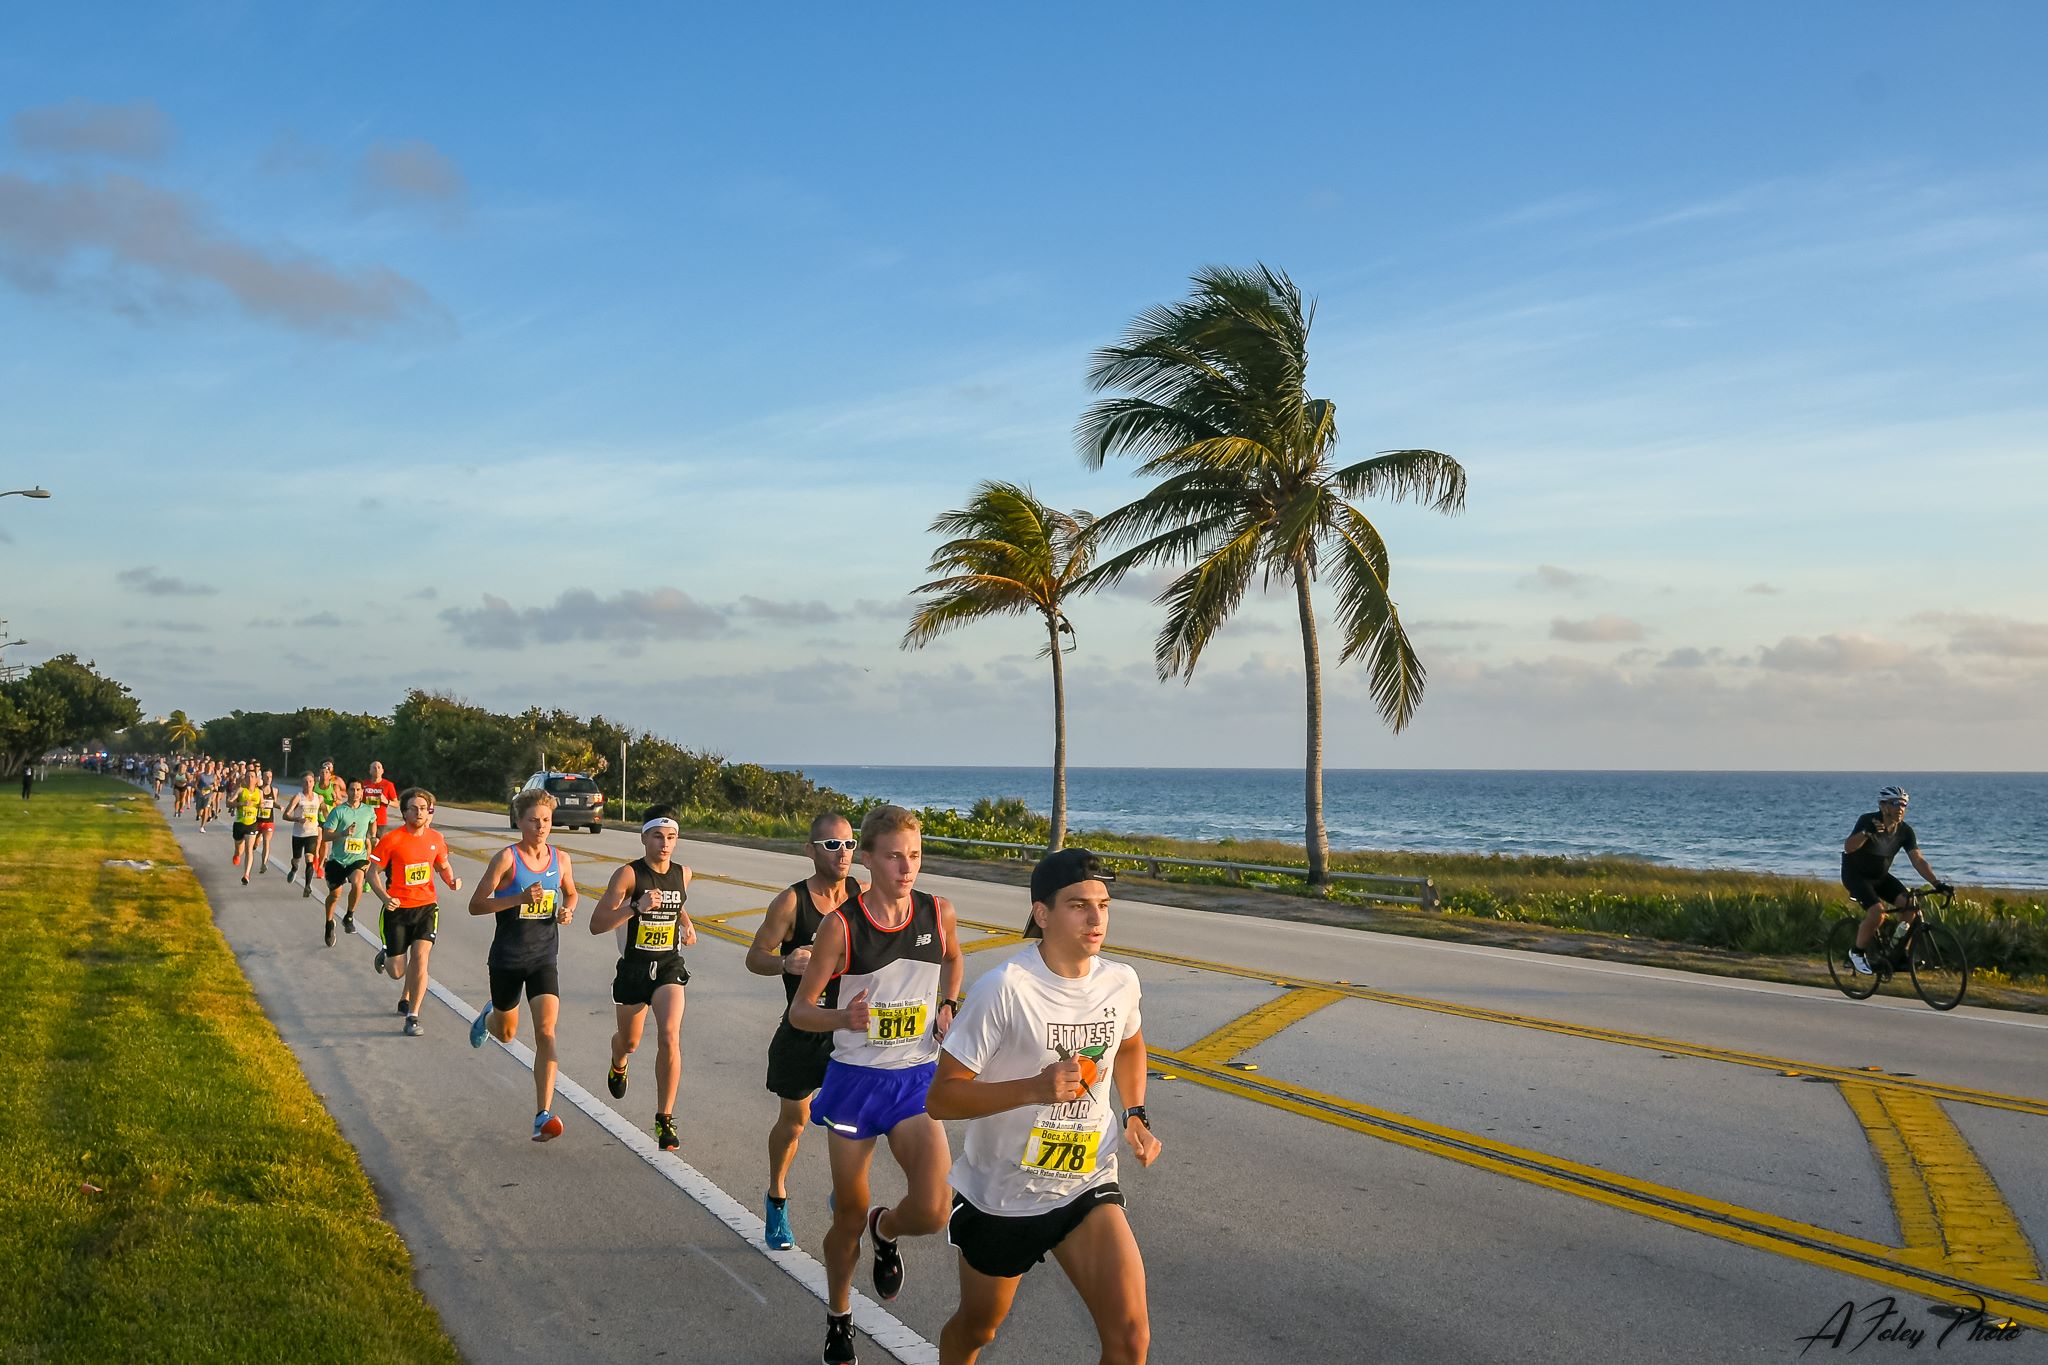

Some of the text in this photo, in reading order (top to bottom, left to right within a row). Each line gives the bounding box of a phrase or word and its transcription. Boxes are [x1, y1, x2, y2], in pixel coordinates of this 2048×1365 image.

[410, 870, 427, 881] 437
[527, 900, 548, 914] 813
[643, 931, 669, 945] 295
[878, 1009, 893, 1017] Boca
[879, 1015, 916, 1038] 814
[1046, 1021, 1115, 1050] FITNESS
[1050, 1099, 1090, 1120] TOUR
[1040, 1120, 1056, 1128] 39th
[1041, 1129, 1093, 1143] Boca 5K & 10K
[1036, 1140, 1087, 1171] 778
